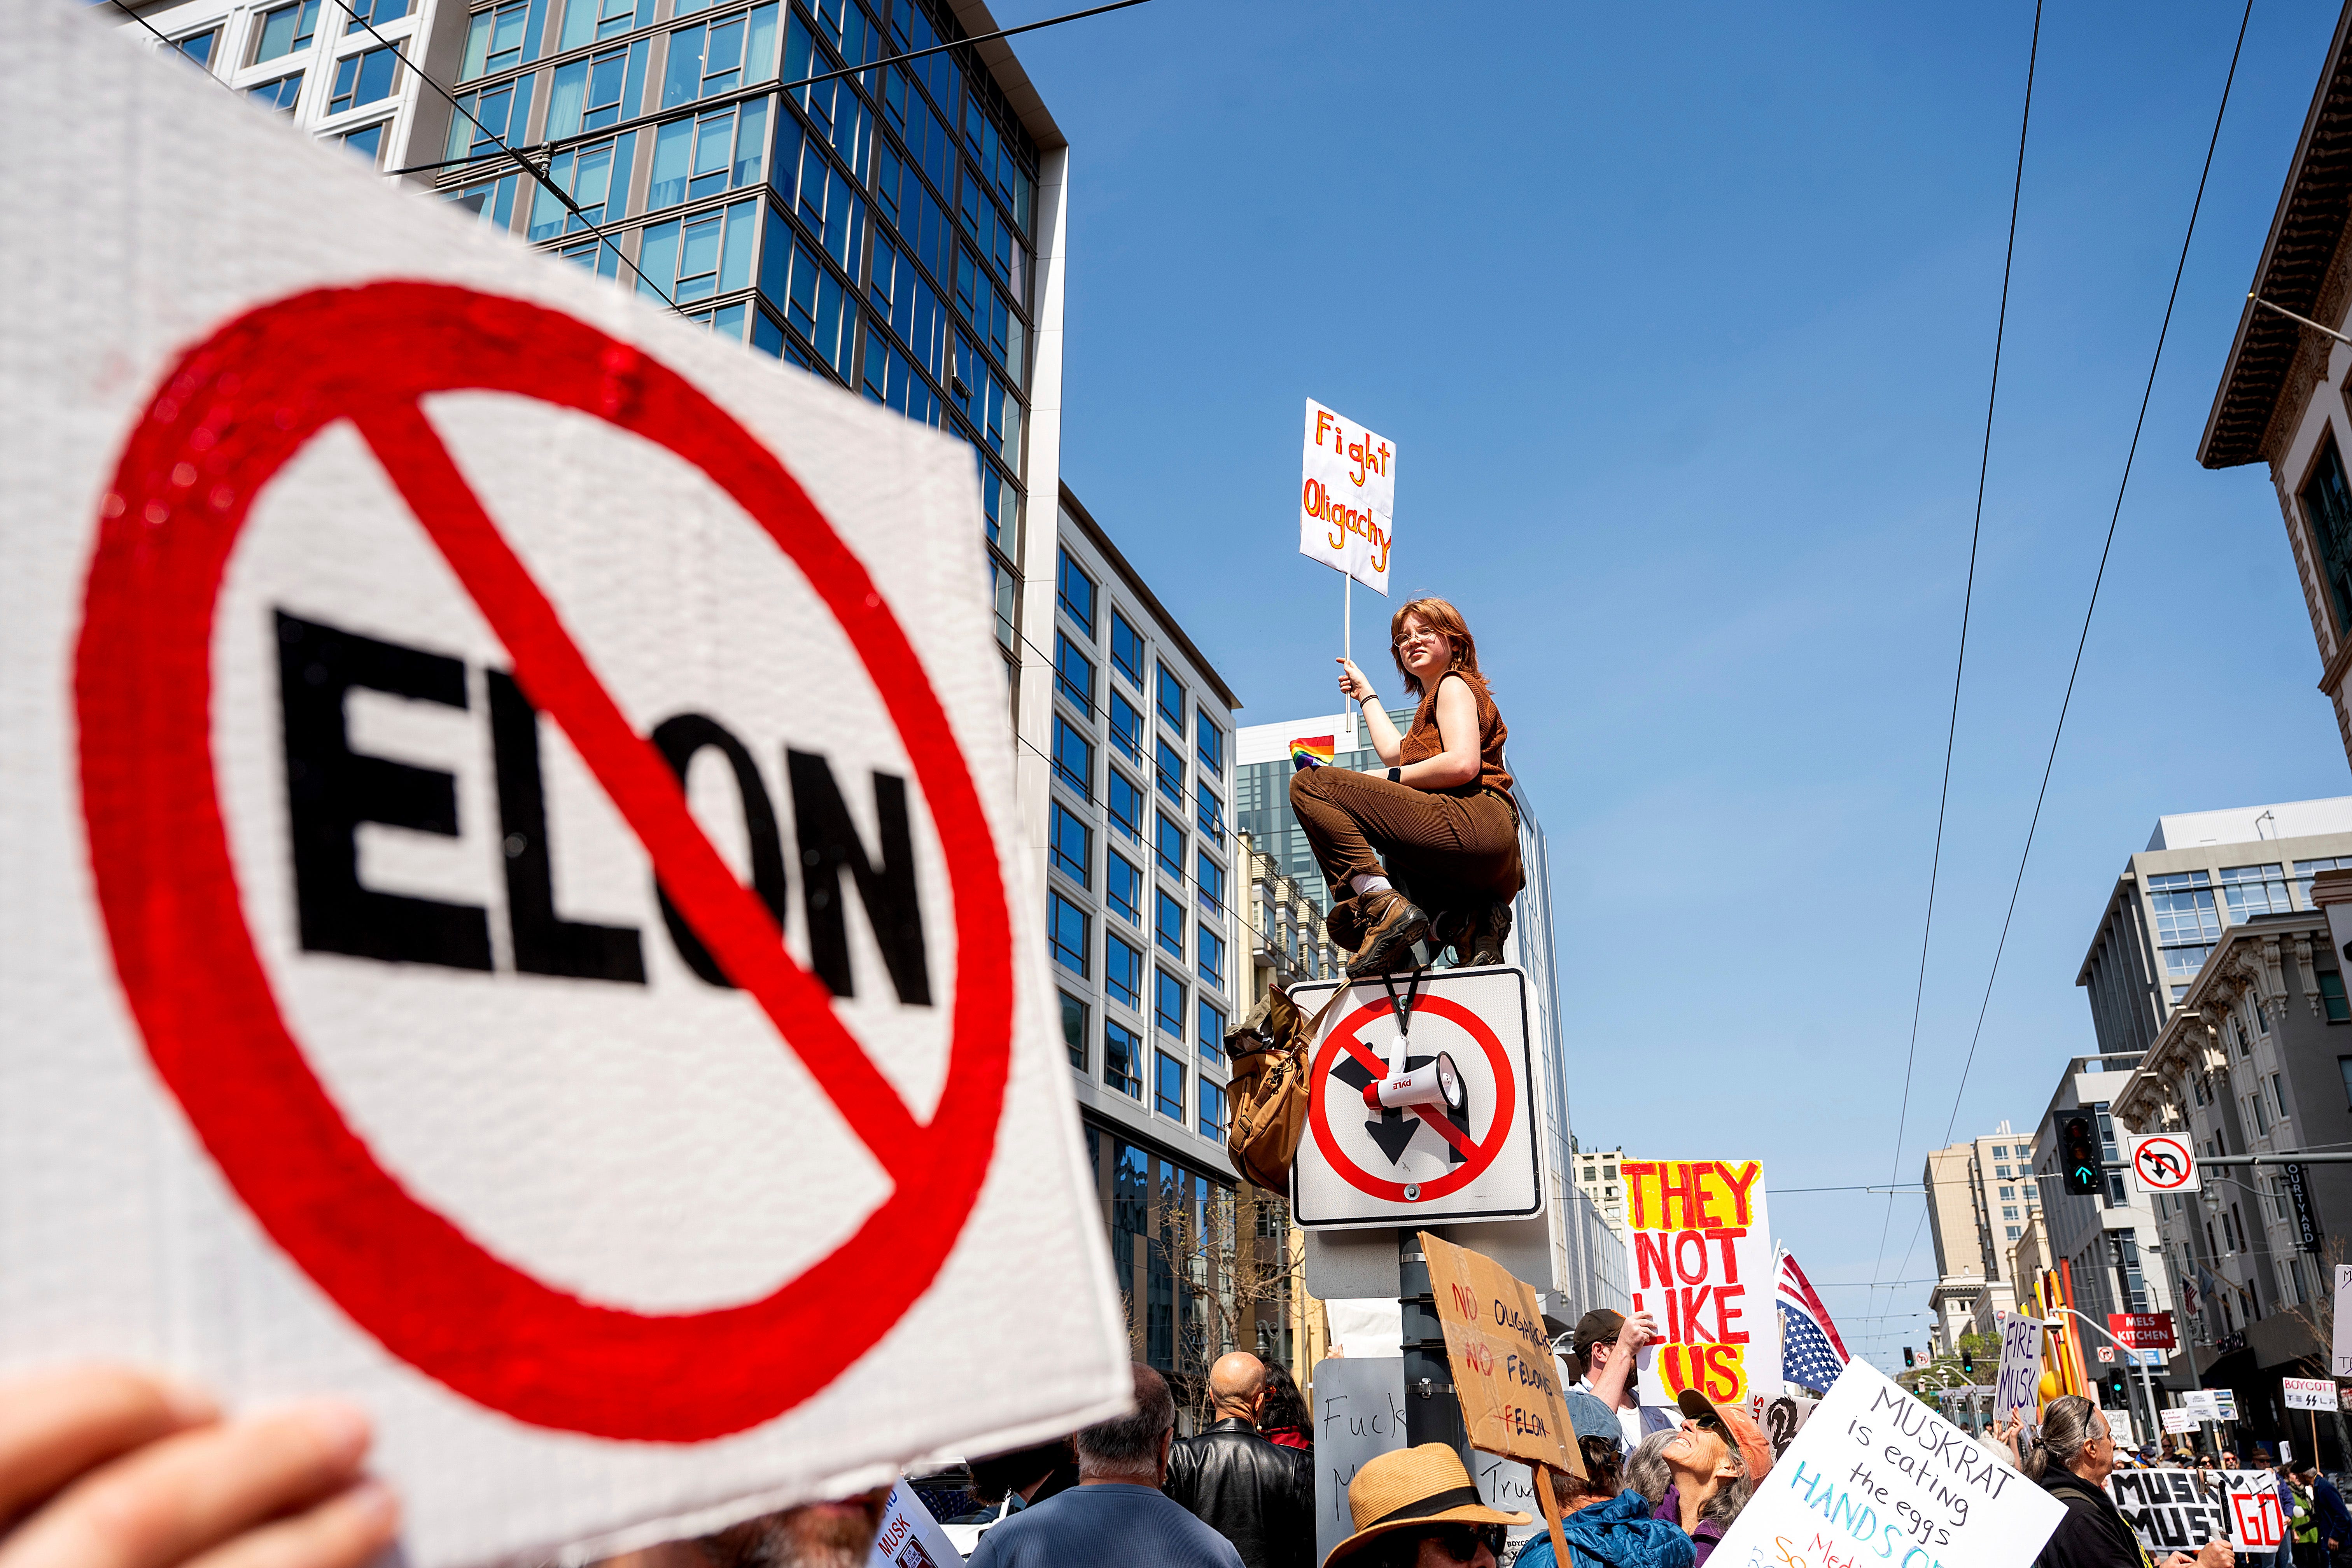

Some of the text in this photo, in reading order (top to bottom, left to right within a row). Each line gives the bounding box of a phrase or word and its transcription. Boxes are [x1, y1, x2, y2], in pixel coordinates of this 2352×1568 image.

[1316, 410, 1390, 487] Fight
[1304, 478, 1391, 572] Oligachy
[272, 607, 933, 1006] ELON
[1393, 1079, 1411, 1090] PYLE
[1620, 1161, 1758, 1229] THEY
[2288, 1164, 2314, 1242] OURTYARD
[1634, 1228, 1747, 1289] NOT
[1452, 1283, 1552, 1356] NO OLIGARCHS
[1632, 1284, 1750, 1347] LIKE
[2005, 1320, 2036, 1363] FIRE
[2117, 1330, 2169, 1341] KITCHEN
[2126, 1316, 2156, 1327] MELS
[1465, 1342, 1553, 1396] NO FELONS
[1664, 1345, 1741, 1404] US
[1998, 1363, 2036, 1411] MUSK
[2284, 1379, 2335, 1392] BOYCOTT
[1324, 1392, 1407, 1441] Fuck
[1502, 1405, 1548, 1438] FELON
[1870, 1386, 2015, 1500] MUSKRAT
[1480, 1461, 1533, 1503] Tru
[1848, 1415, 1969, 1526] is eating
[1791, 1461, 1902, 1558] HANDS
[1850, 1462, 1950, 1545] the eggs
[2231, 1493, 2285, 1546] GO
[878, 1512, 911, 1558] MUSK
